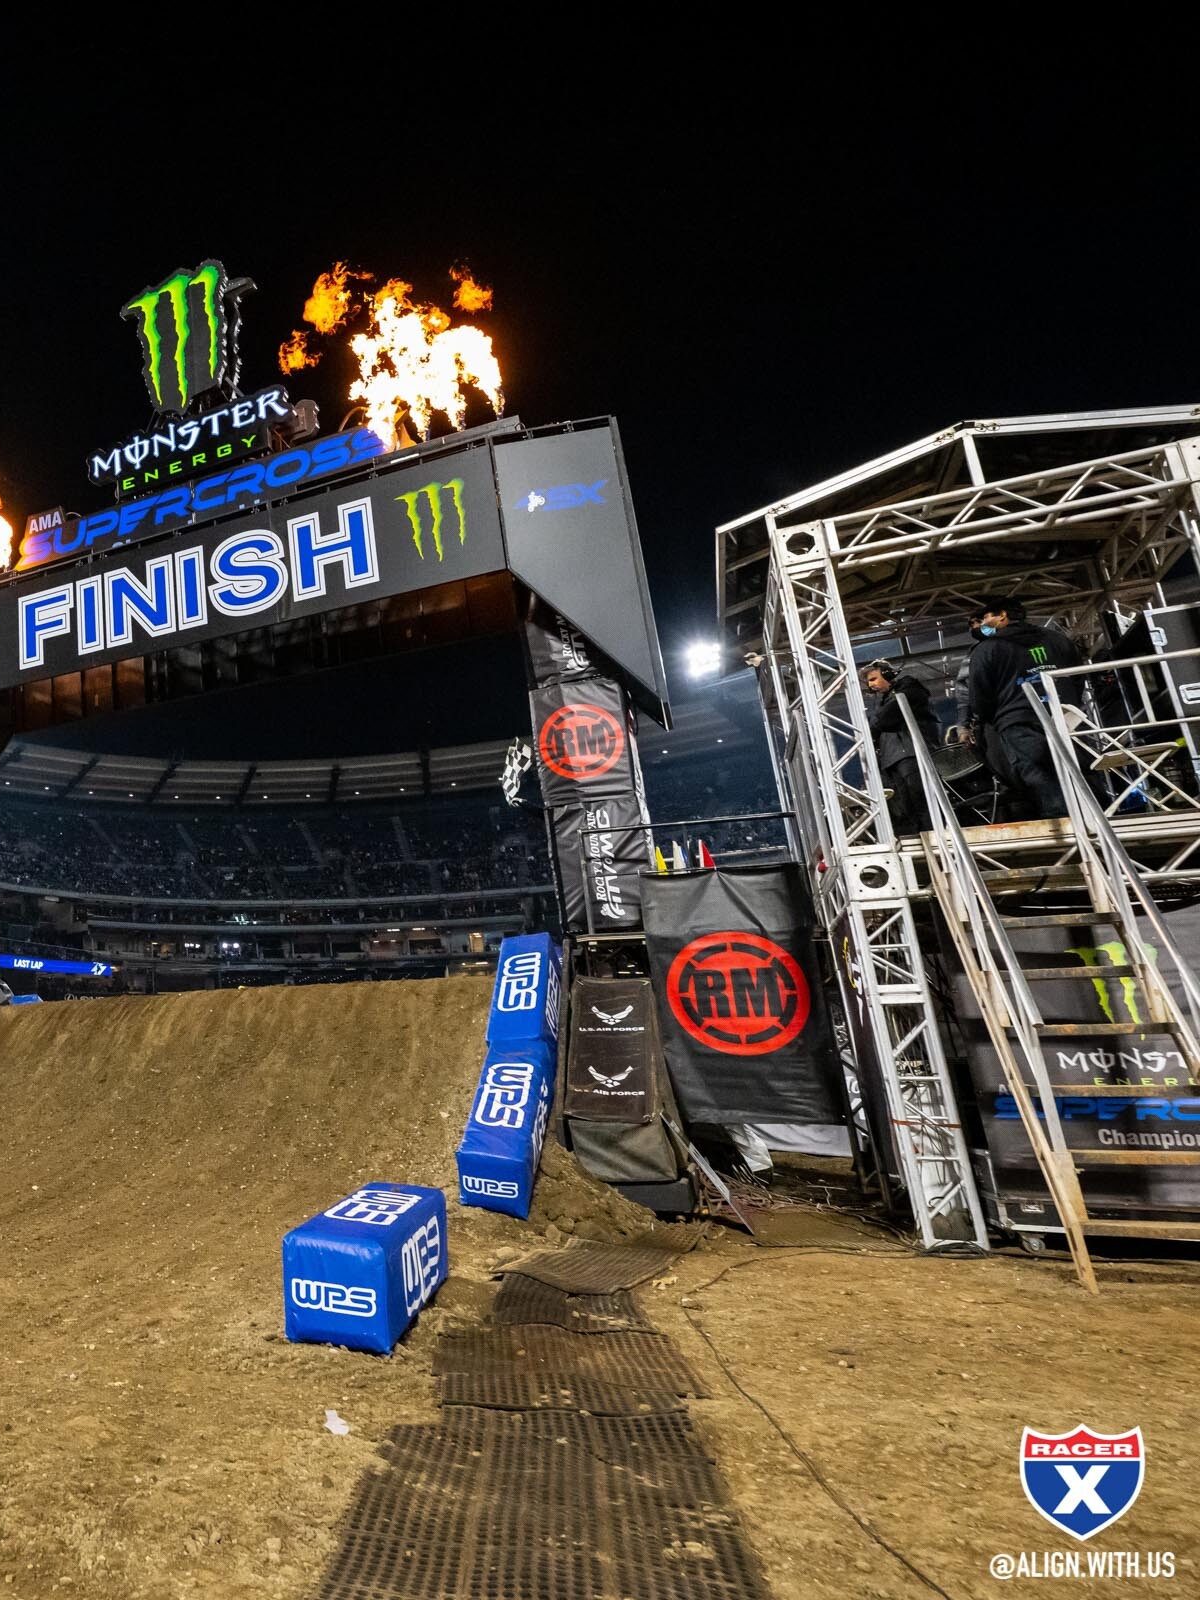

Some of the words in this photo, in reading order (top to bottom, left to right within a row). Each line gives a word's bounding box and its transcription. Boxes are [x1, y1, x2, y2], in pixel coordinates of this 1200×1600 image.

[92, 389, 288, 479] MONSTER
[122, 434, 256, 491] ENERGY
[15, 428, 390, 570] SUPERCROSS
[29, 511, 62, 534] AMA
[18, 496, 380, 670] FINISH
[554, 721, 614, 758] RM
[13, 958, 29, 968] LAST
[30, 961, 43, 970] LAP
[498, 951, 541, 1012] WPS
[691, 967, 784, 1018] RM
[475, 1063, 534, 1128] WPS
[592, 1088, 610, 1096] AIR
[462, 1176, 518, 1198] WPS
[291, 1278, 377, 1318] WPS
